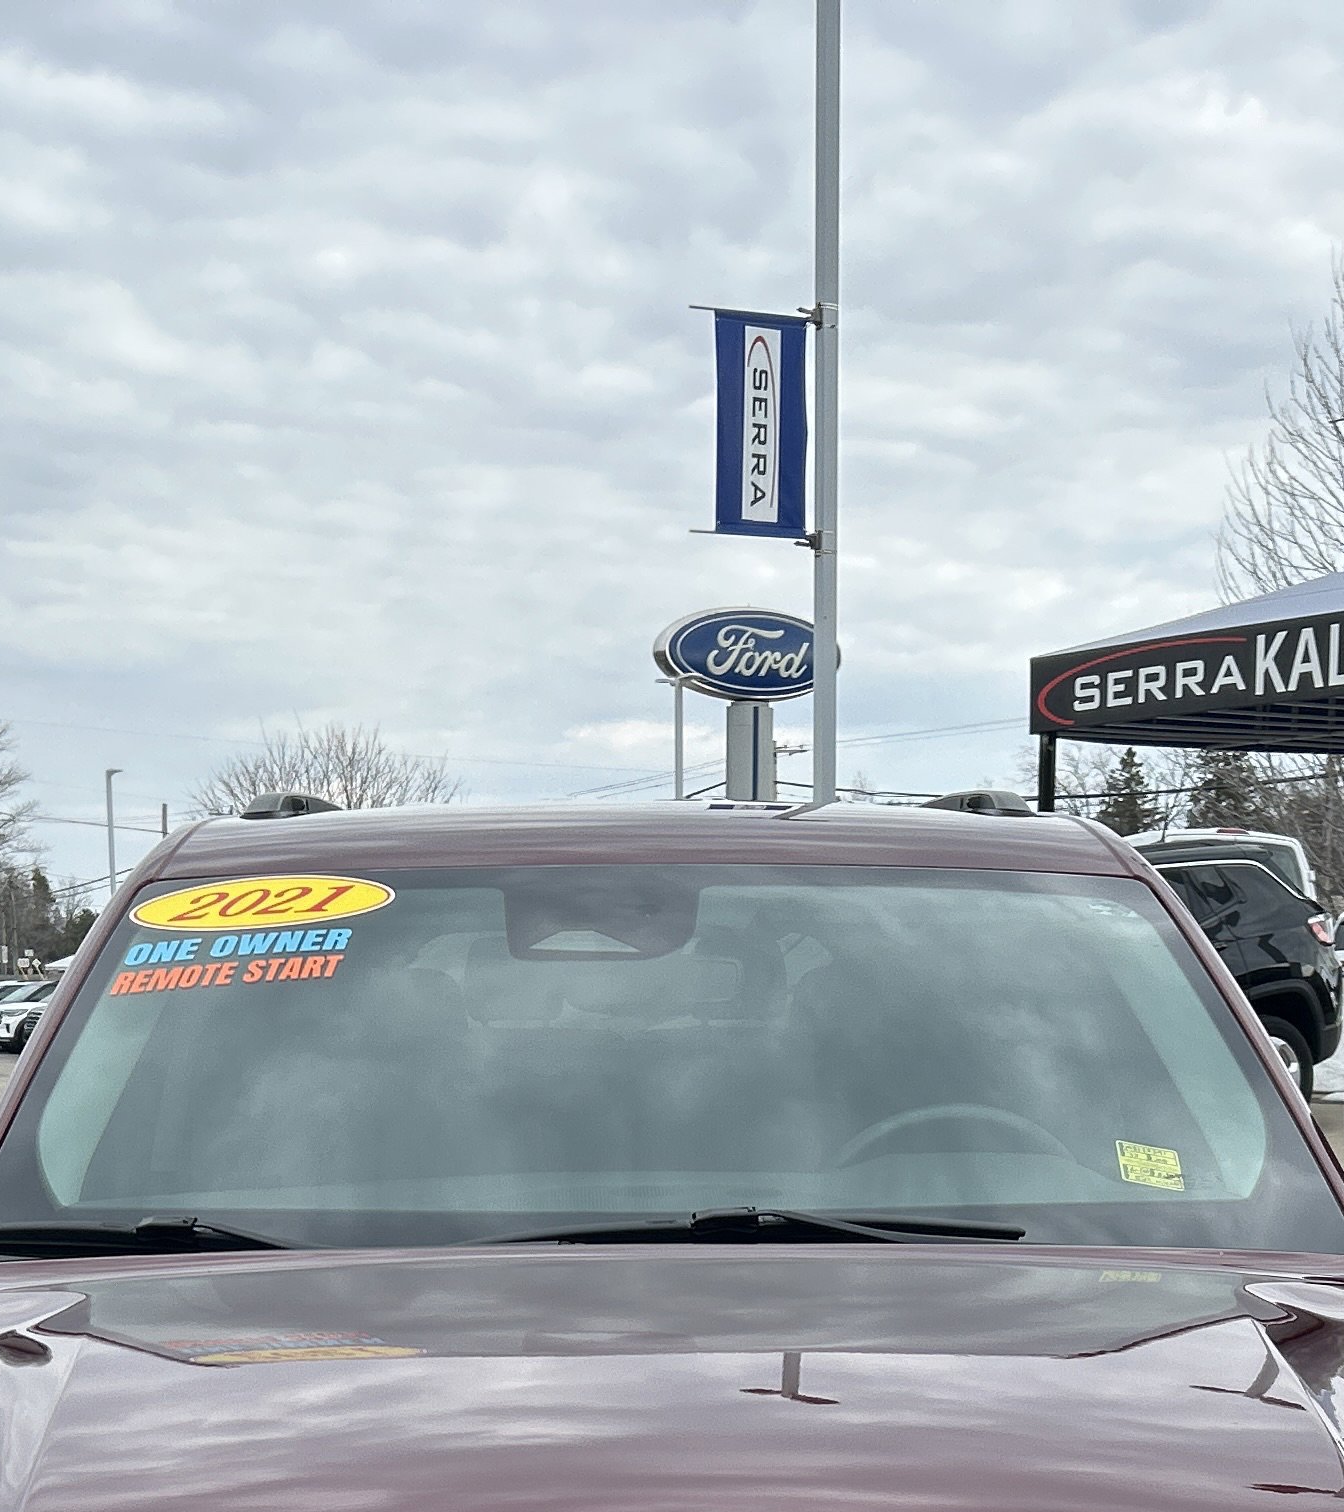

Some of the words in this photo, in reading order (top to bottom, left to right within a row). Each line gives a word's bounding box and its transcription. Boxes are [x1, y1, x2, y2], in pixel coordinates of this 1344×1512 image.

[750, 367, 768, 507] SERRA
[707, 625, 809, 678] Ford
[1073, 655, 1246, 712] SERRA
[167, 885, 356, 922] 2021
[124, 938, 202, 966] ONE
[210, 928, 353, 958] OWNER
[109, 961, 239, 996] REMOTE
[242, 954, 344, 984] START
